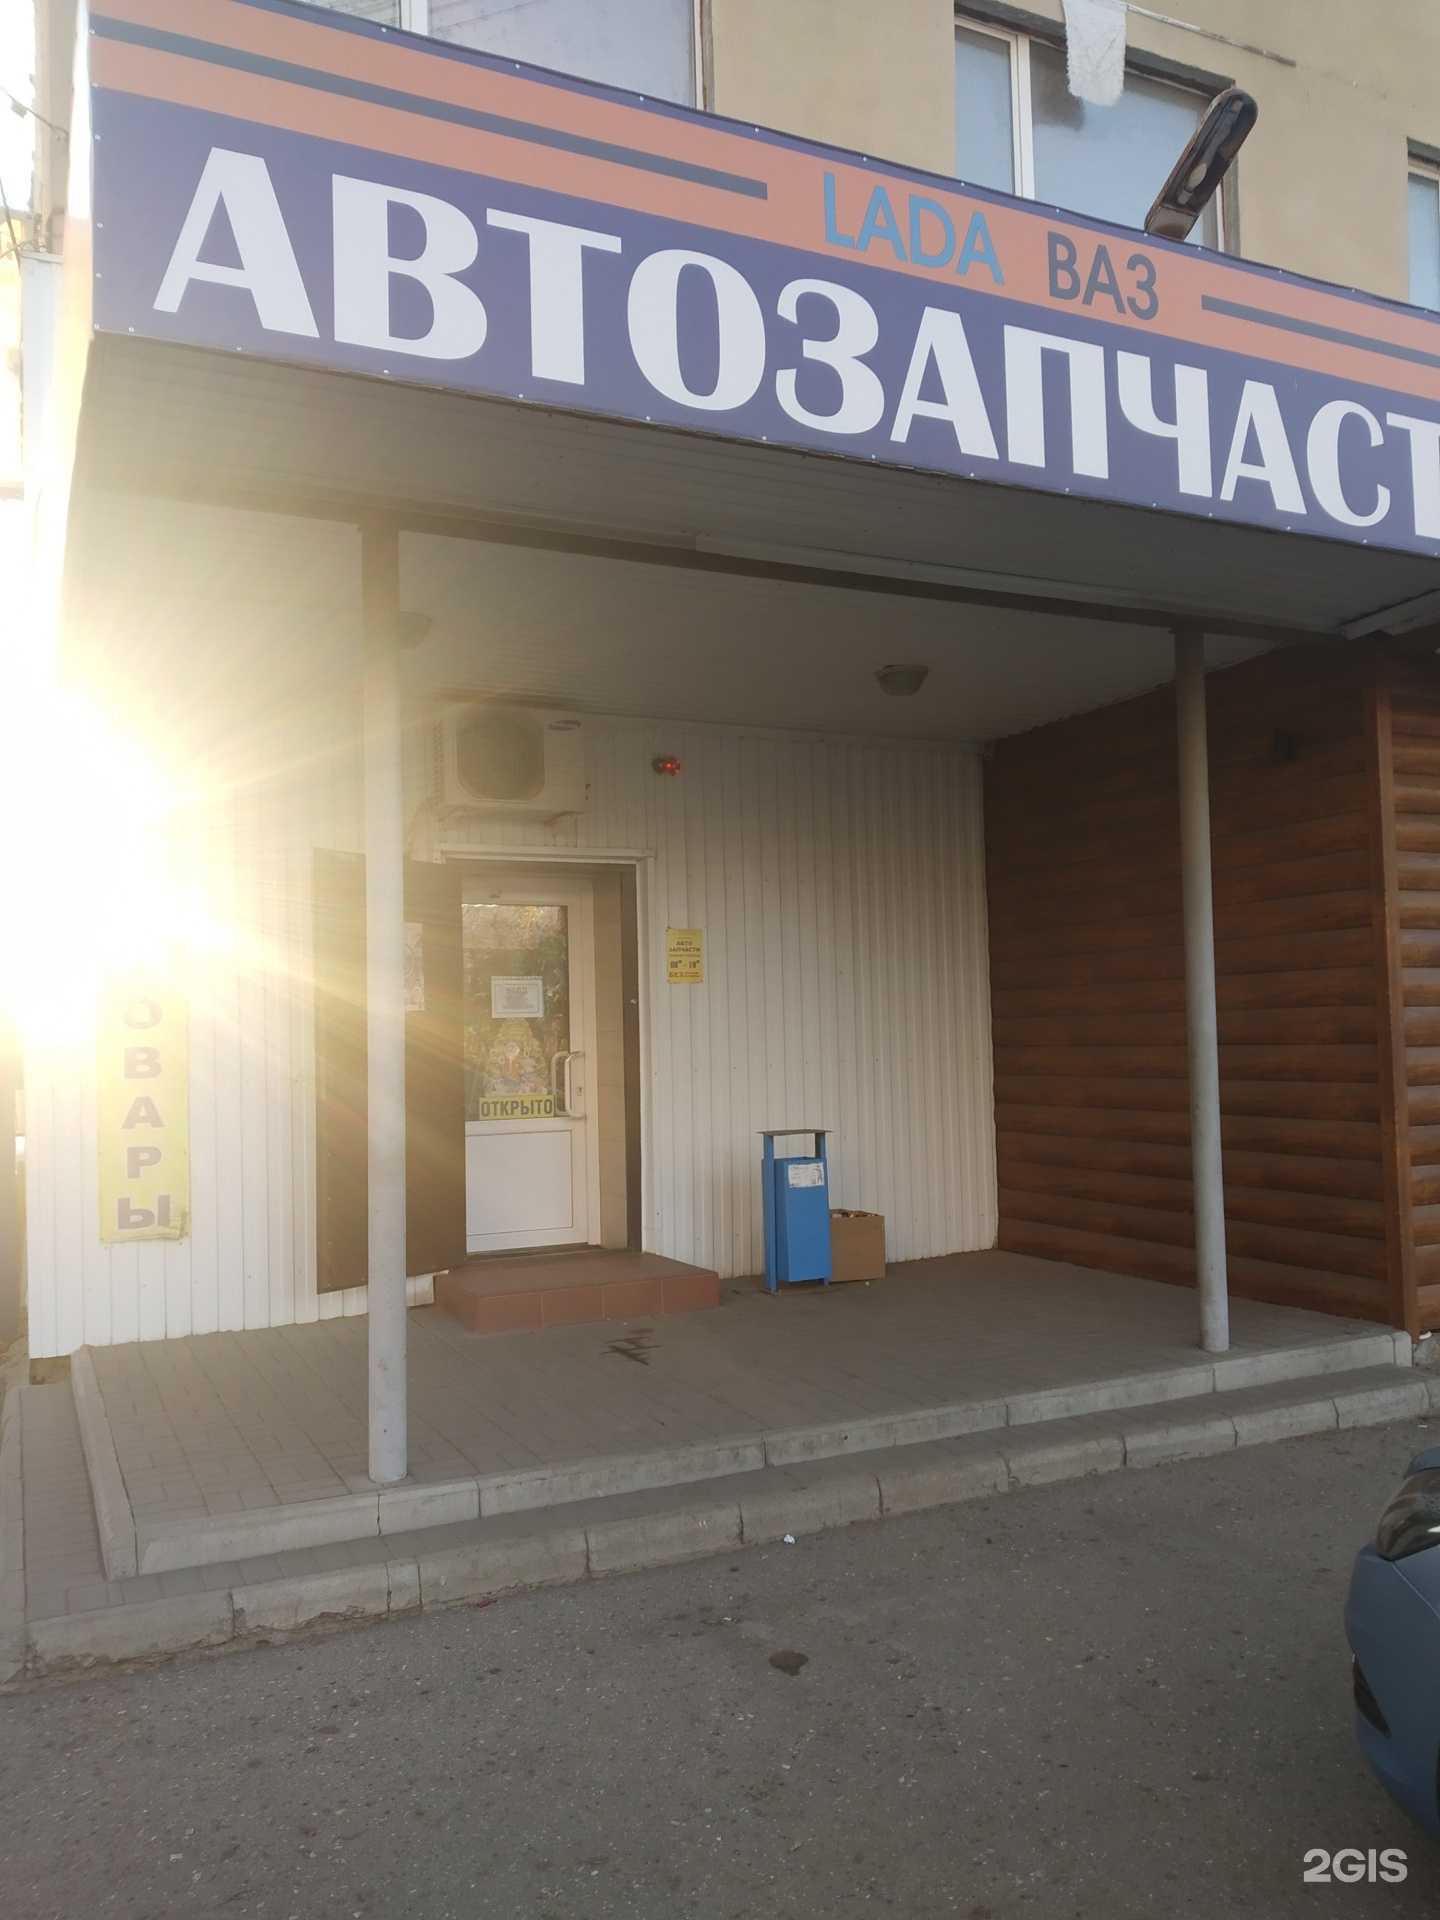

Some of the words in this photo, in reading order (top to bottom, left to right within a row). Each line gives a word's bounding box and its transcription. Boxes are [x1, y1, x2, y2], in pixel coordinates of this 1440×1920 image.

[823, 171, 1005, 285] LADA
[1047, 231, 1160, 321] ВАЗ
[152, 146, 1440, 540] АВТОЗАПЧАСТ
[115, 996, 172, 1231] ОВАРЫ
[480, 1098, 553, 1118] ОТКРЫТО
